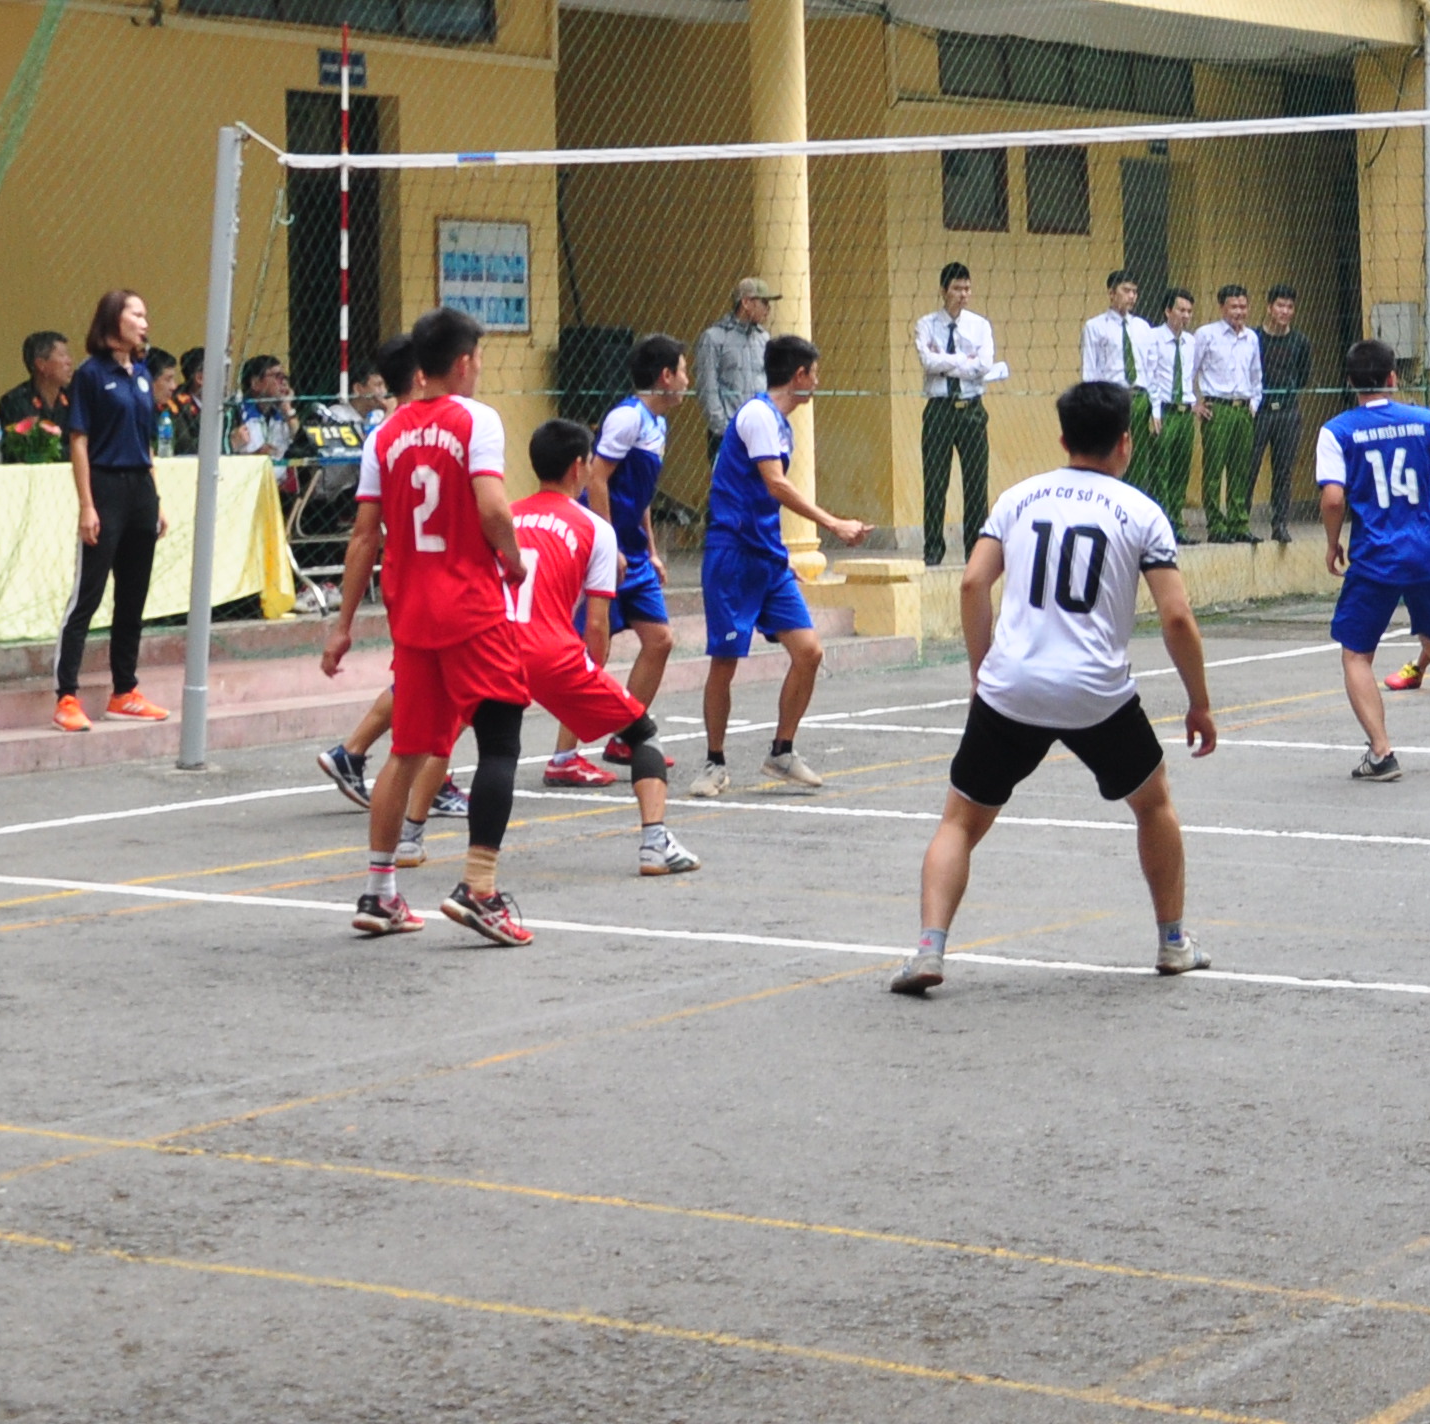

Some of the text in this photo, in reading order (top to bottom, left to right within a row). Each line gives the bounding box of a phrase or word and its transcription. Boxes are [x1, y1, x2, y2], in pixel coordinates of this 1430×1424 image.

[410, 464, 447, 553] 2
[1364, 447, 1420, 509] 14
[1029, 519, 1108, 614] 10
